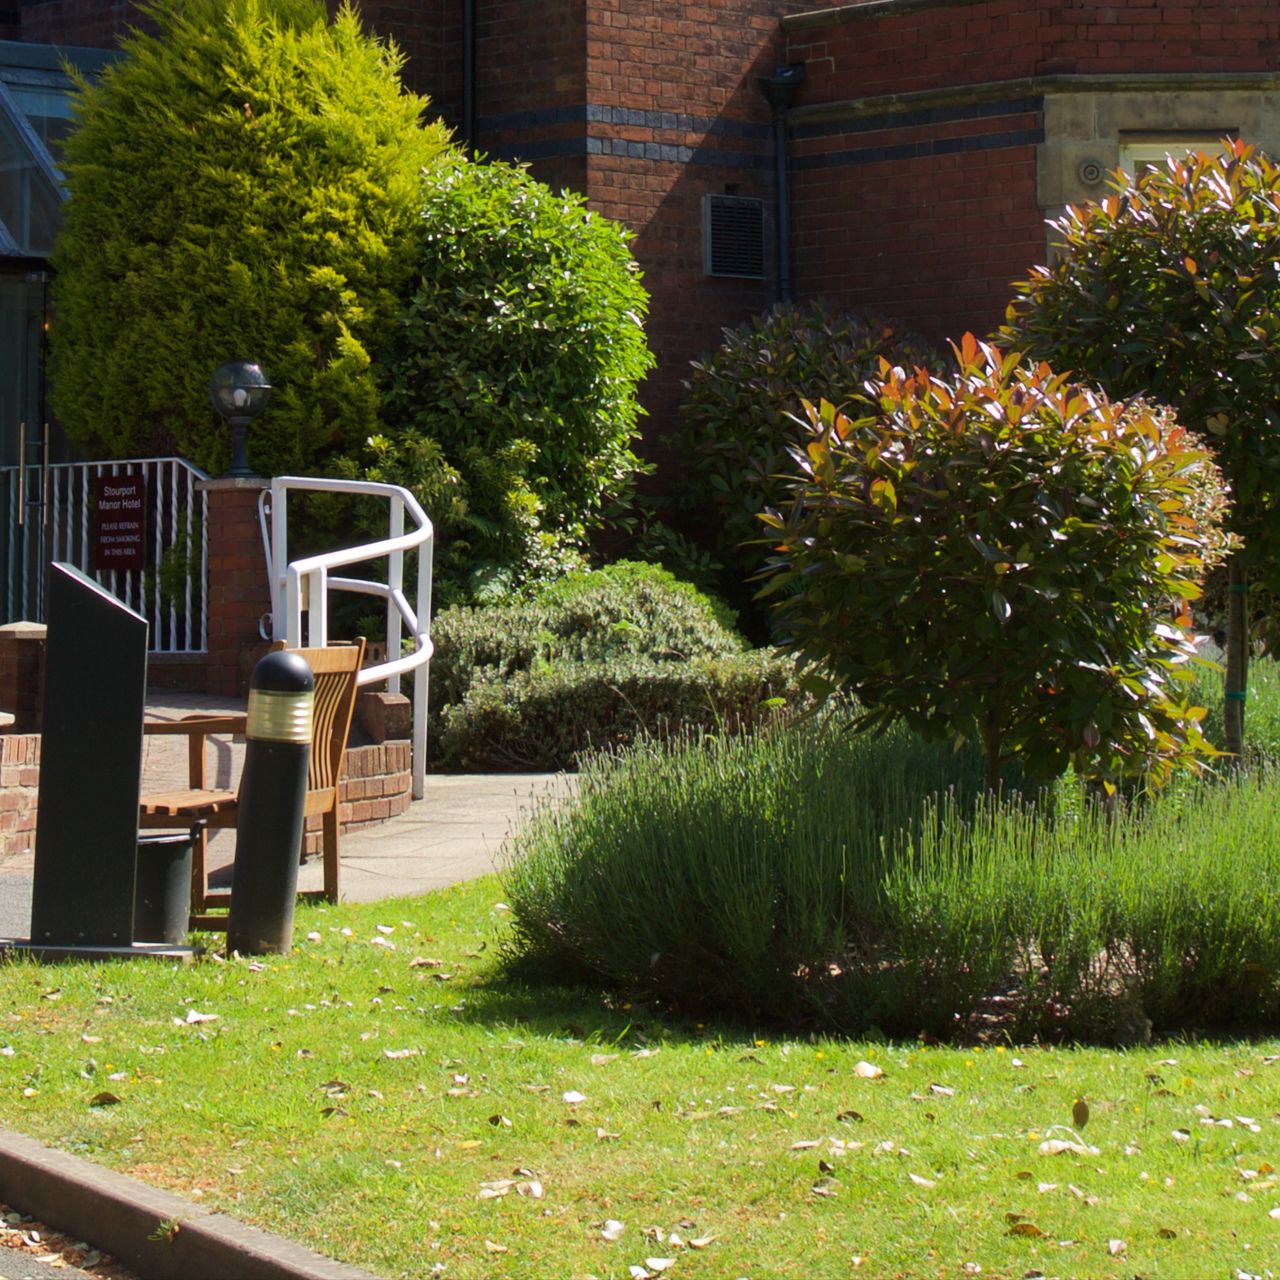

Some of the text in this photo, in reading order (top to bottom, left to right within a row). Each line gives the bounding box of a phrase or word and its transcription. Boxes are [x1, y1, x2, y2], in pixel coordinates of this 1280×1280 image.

[104, 485, 136, 497] Stourport
[98, 498, 141, 510] Manor Hotel
[123, 547, 136, 555] AREA
